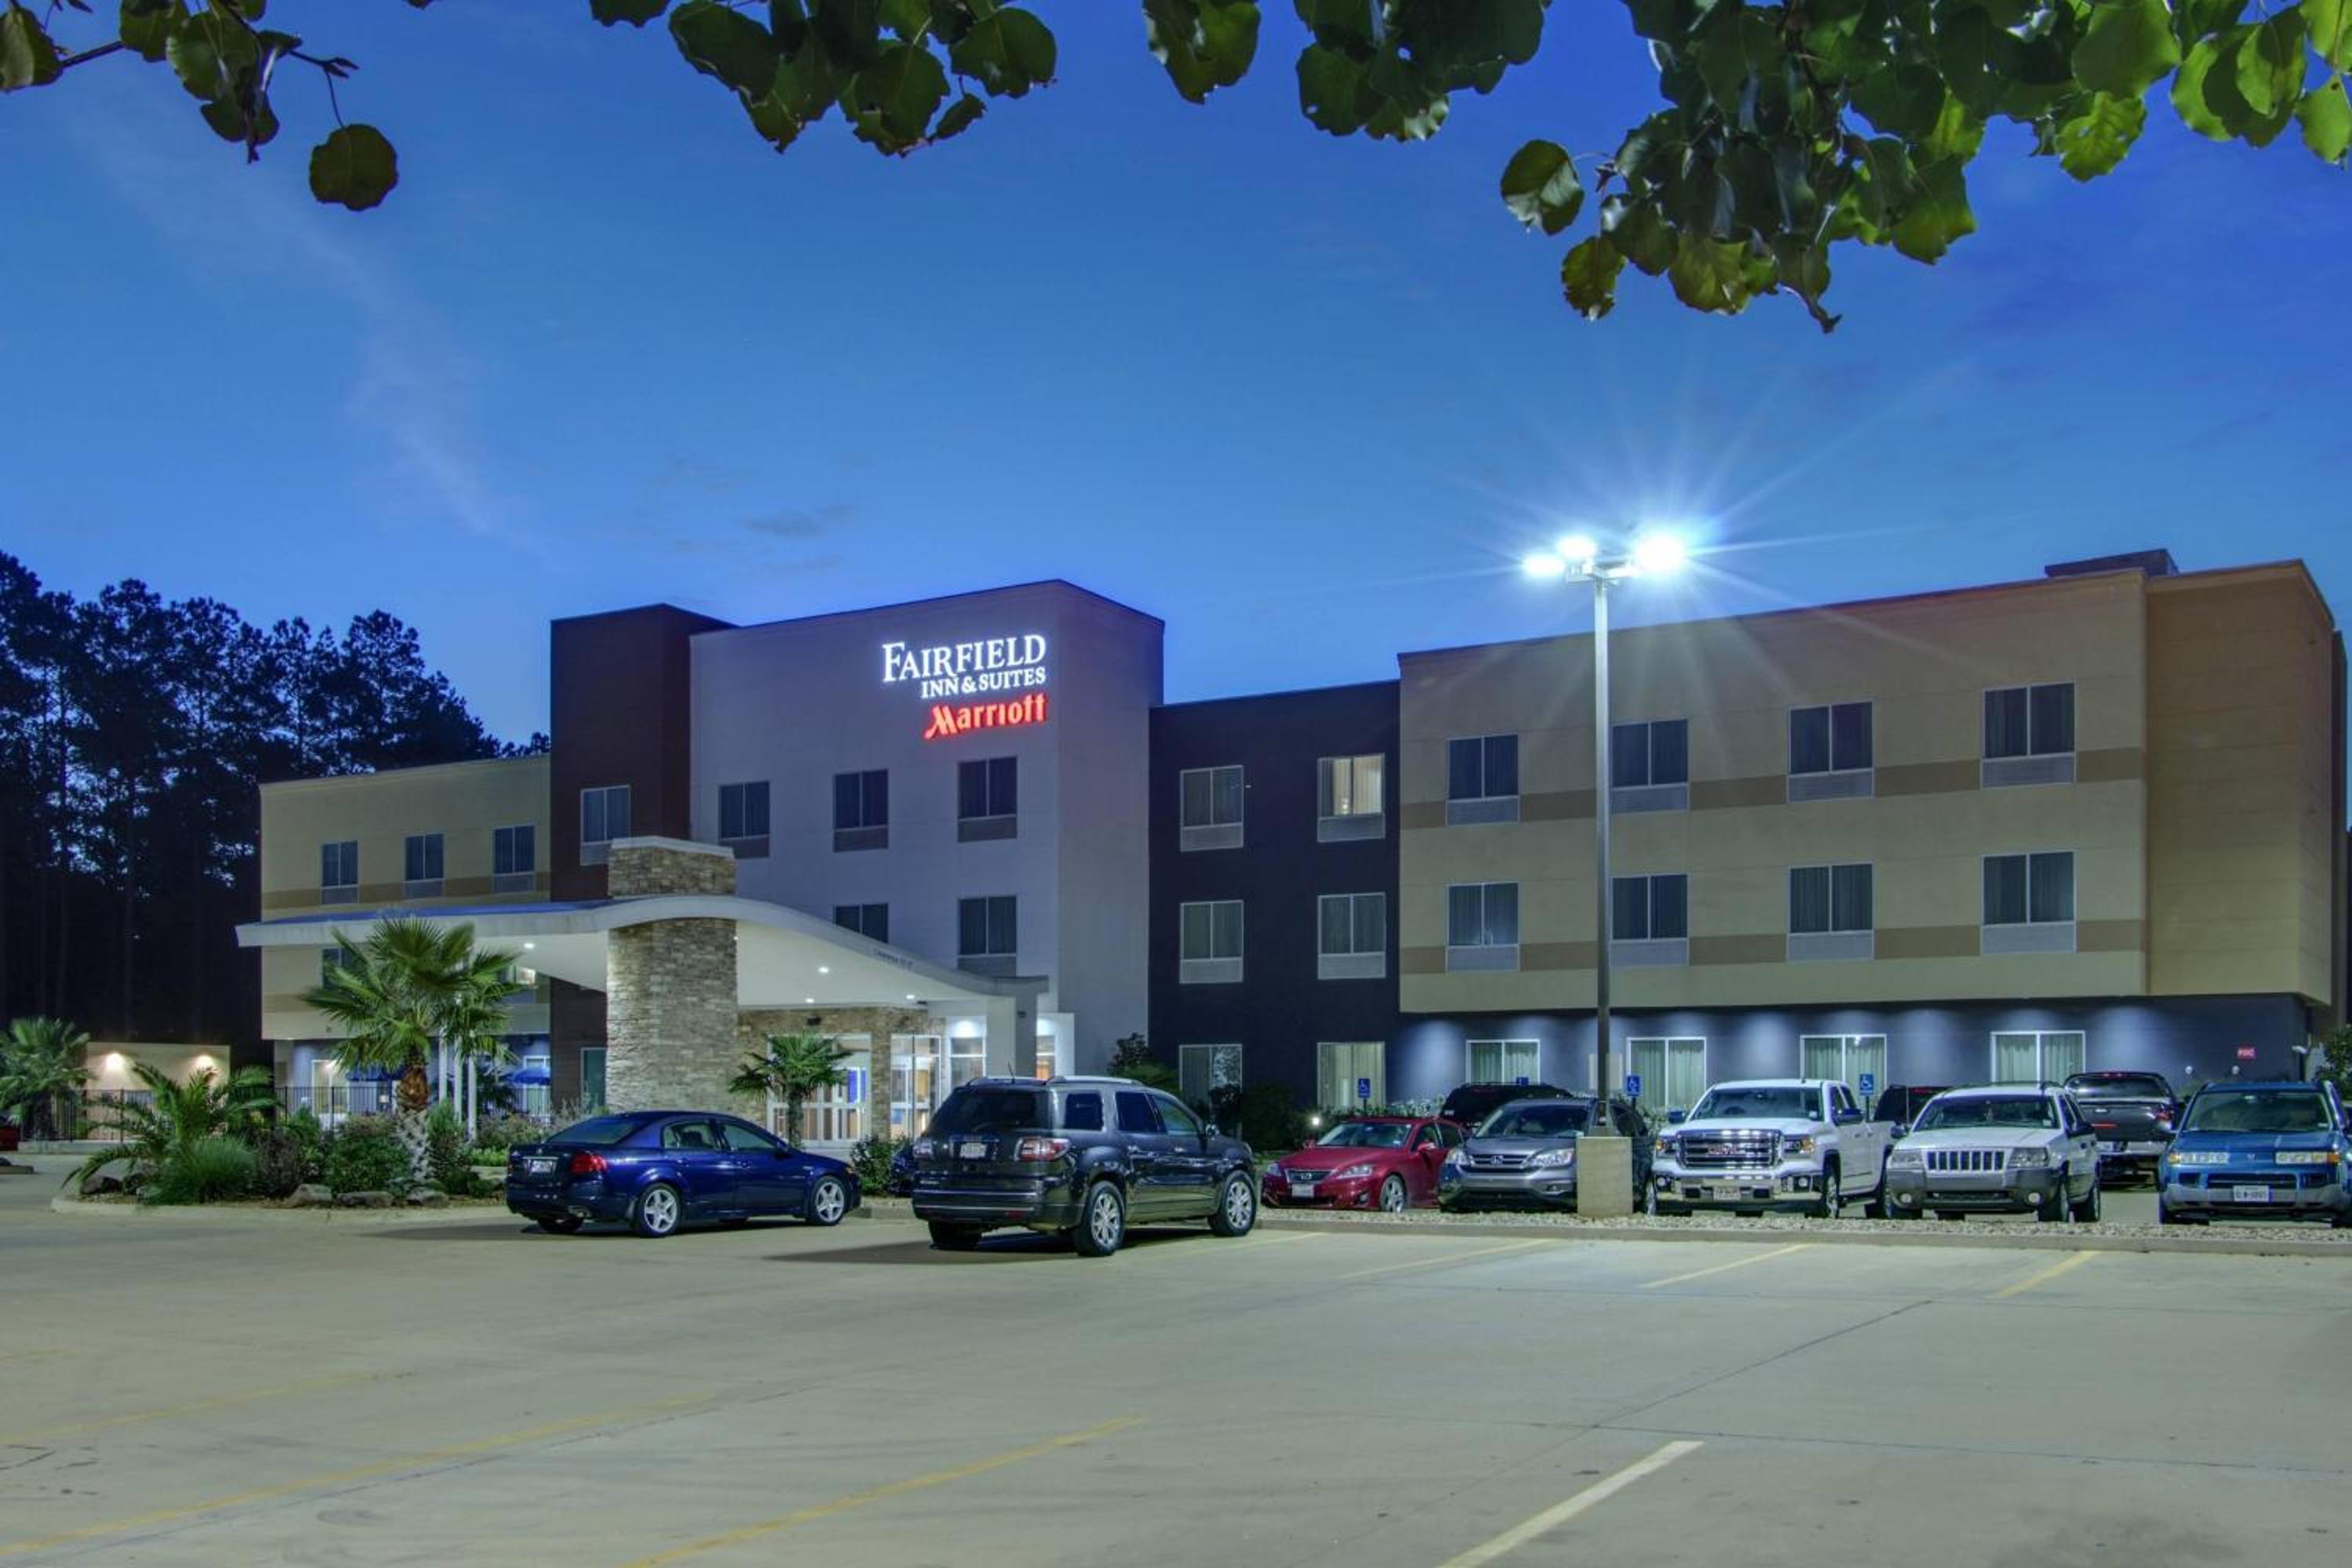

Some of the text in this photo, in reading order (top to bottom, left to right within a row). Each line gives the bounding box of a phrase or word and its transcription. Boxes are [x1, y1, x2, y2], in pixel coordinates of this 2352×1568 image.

[881, 633, 1047, 683] FAIRFIELD
[920, 677, 959, 699] INN
[978, 666, 1047, 691] SUITES
[923, 692, 1047, 739] Marriott
